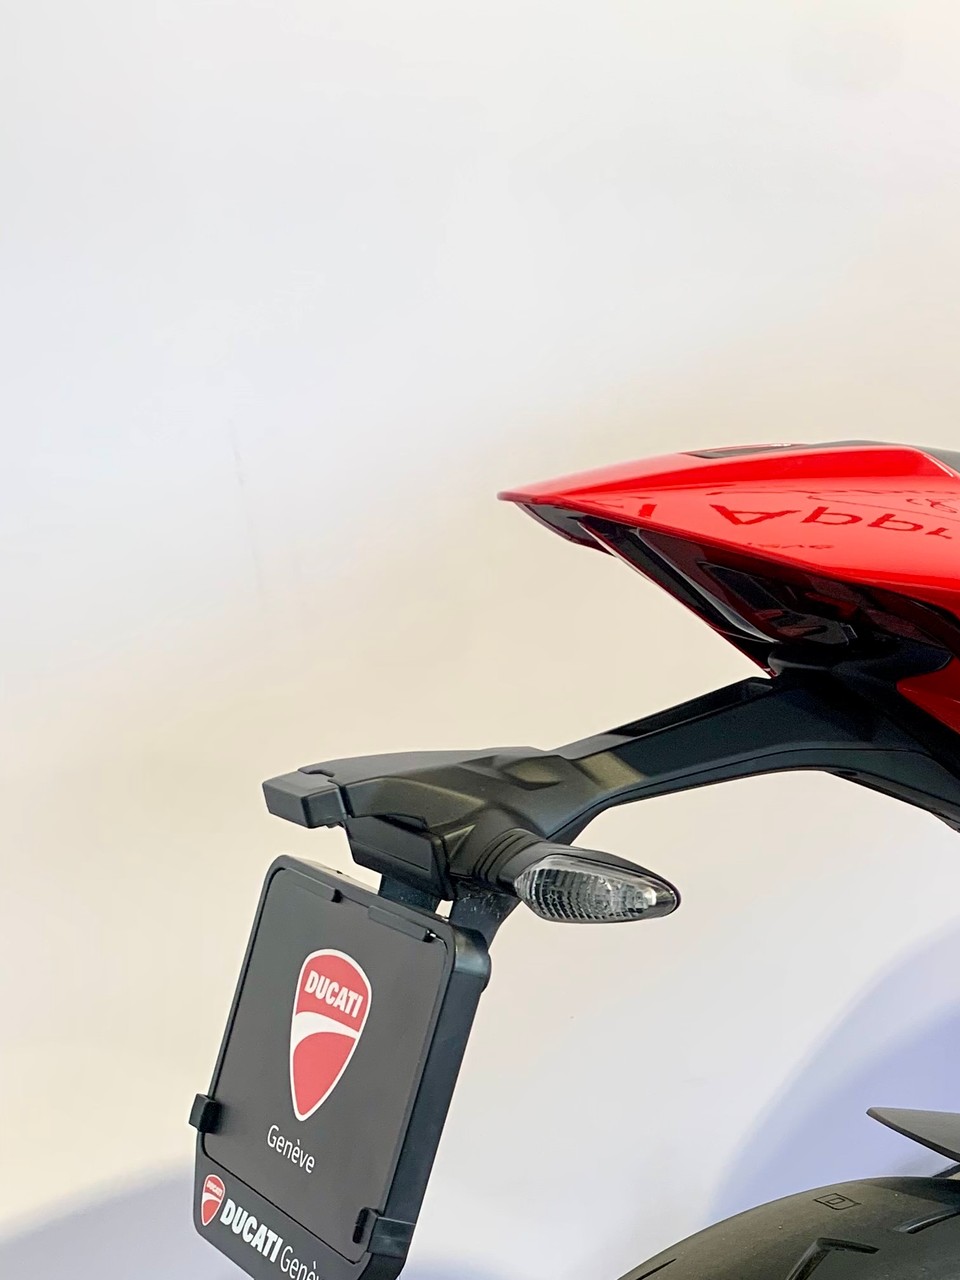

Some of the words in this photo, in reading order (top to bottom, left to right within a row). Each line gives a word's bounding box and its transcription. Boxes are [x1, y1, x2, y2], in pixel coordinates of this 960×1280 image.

[302, 968, 364, 1019] DUCATI
[266, 1124, 316, 1174] Genève
[219, 1198, 284, 1263] DUCATI
